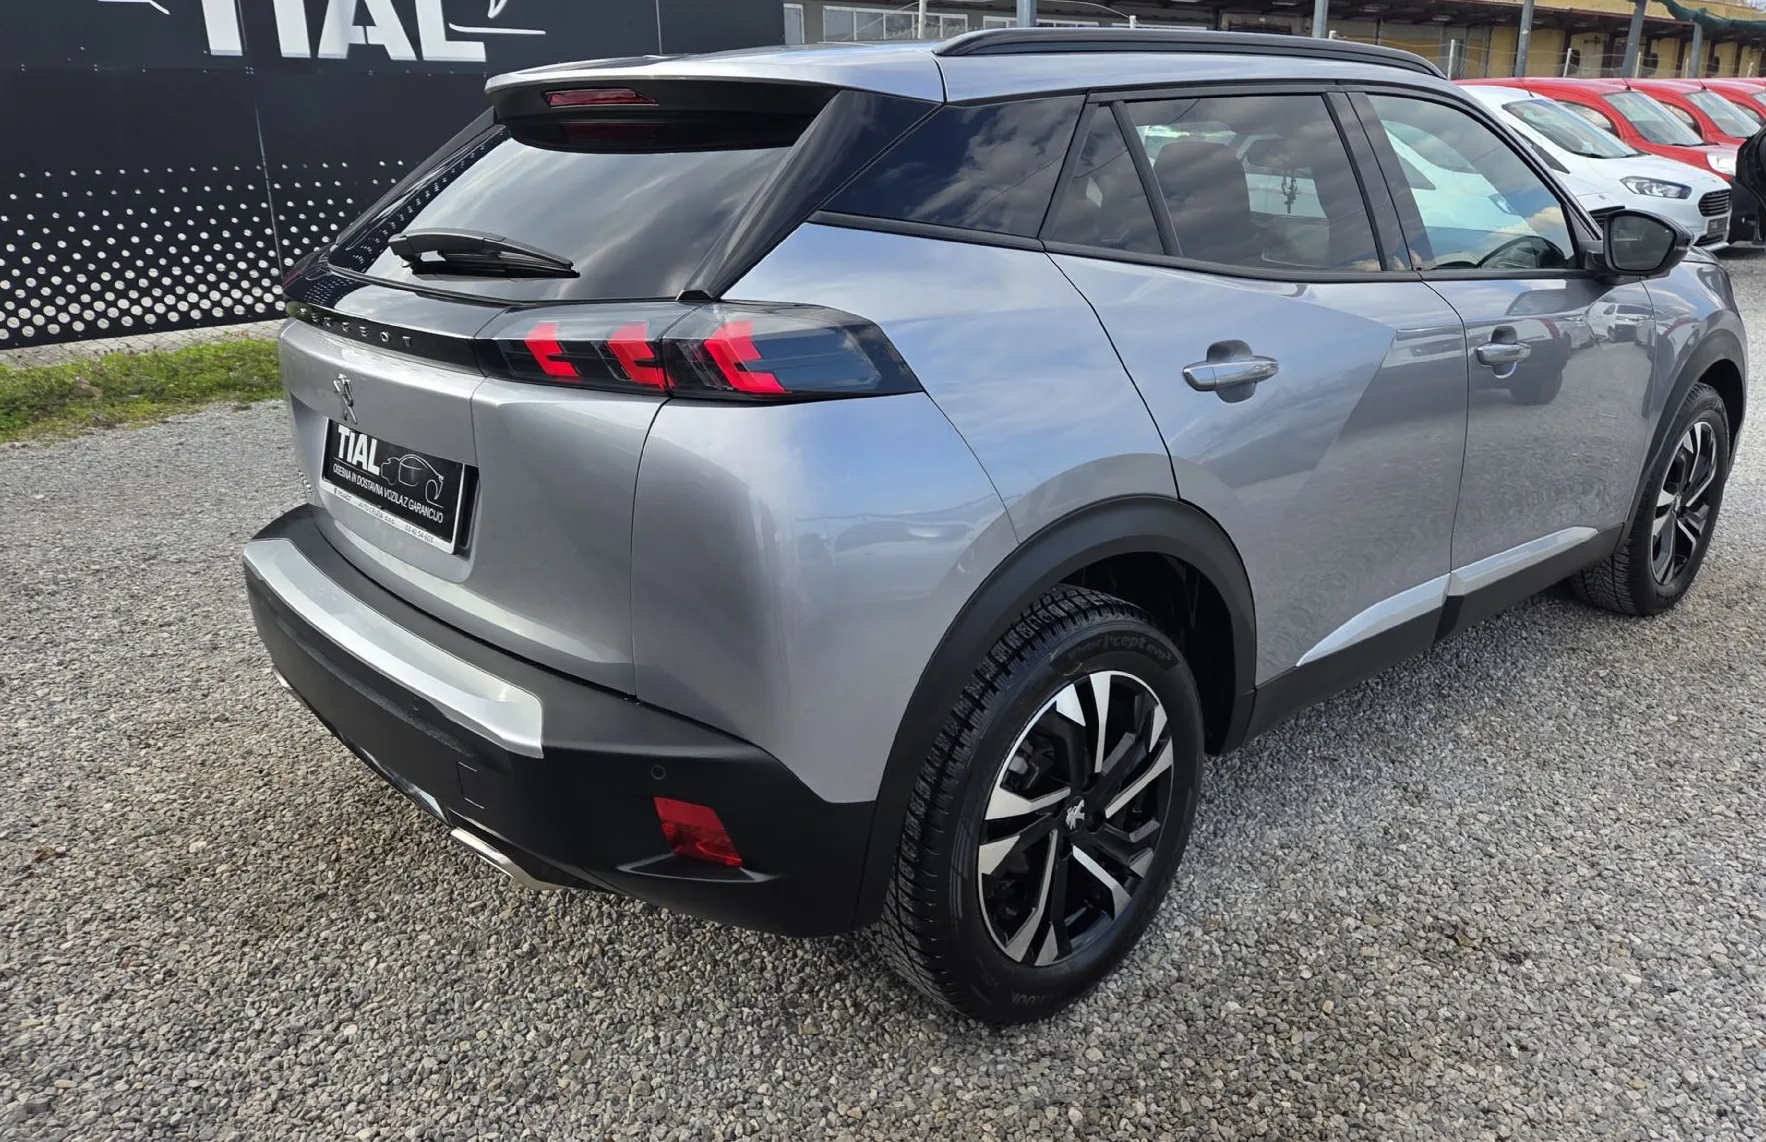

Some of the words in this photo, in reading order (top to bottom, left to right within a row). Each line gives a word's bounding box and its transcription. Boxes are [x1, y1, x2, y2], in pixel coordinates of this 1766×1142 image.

[338, 424, 380, 475] TIAL
[356, 475, 384, 497] DOSTAVNA
[384, 487, 403, 506] VOZILA
[408, 500, 443, 523] GARANCIJO
